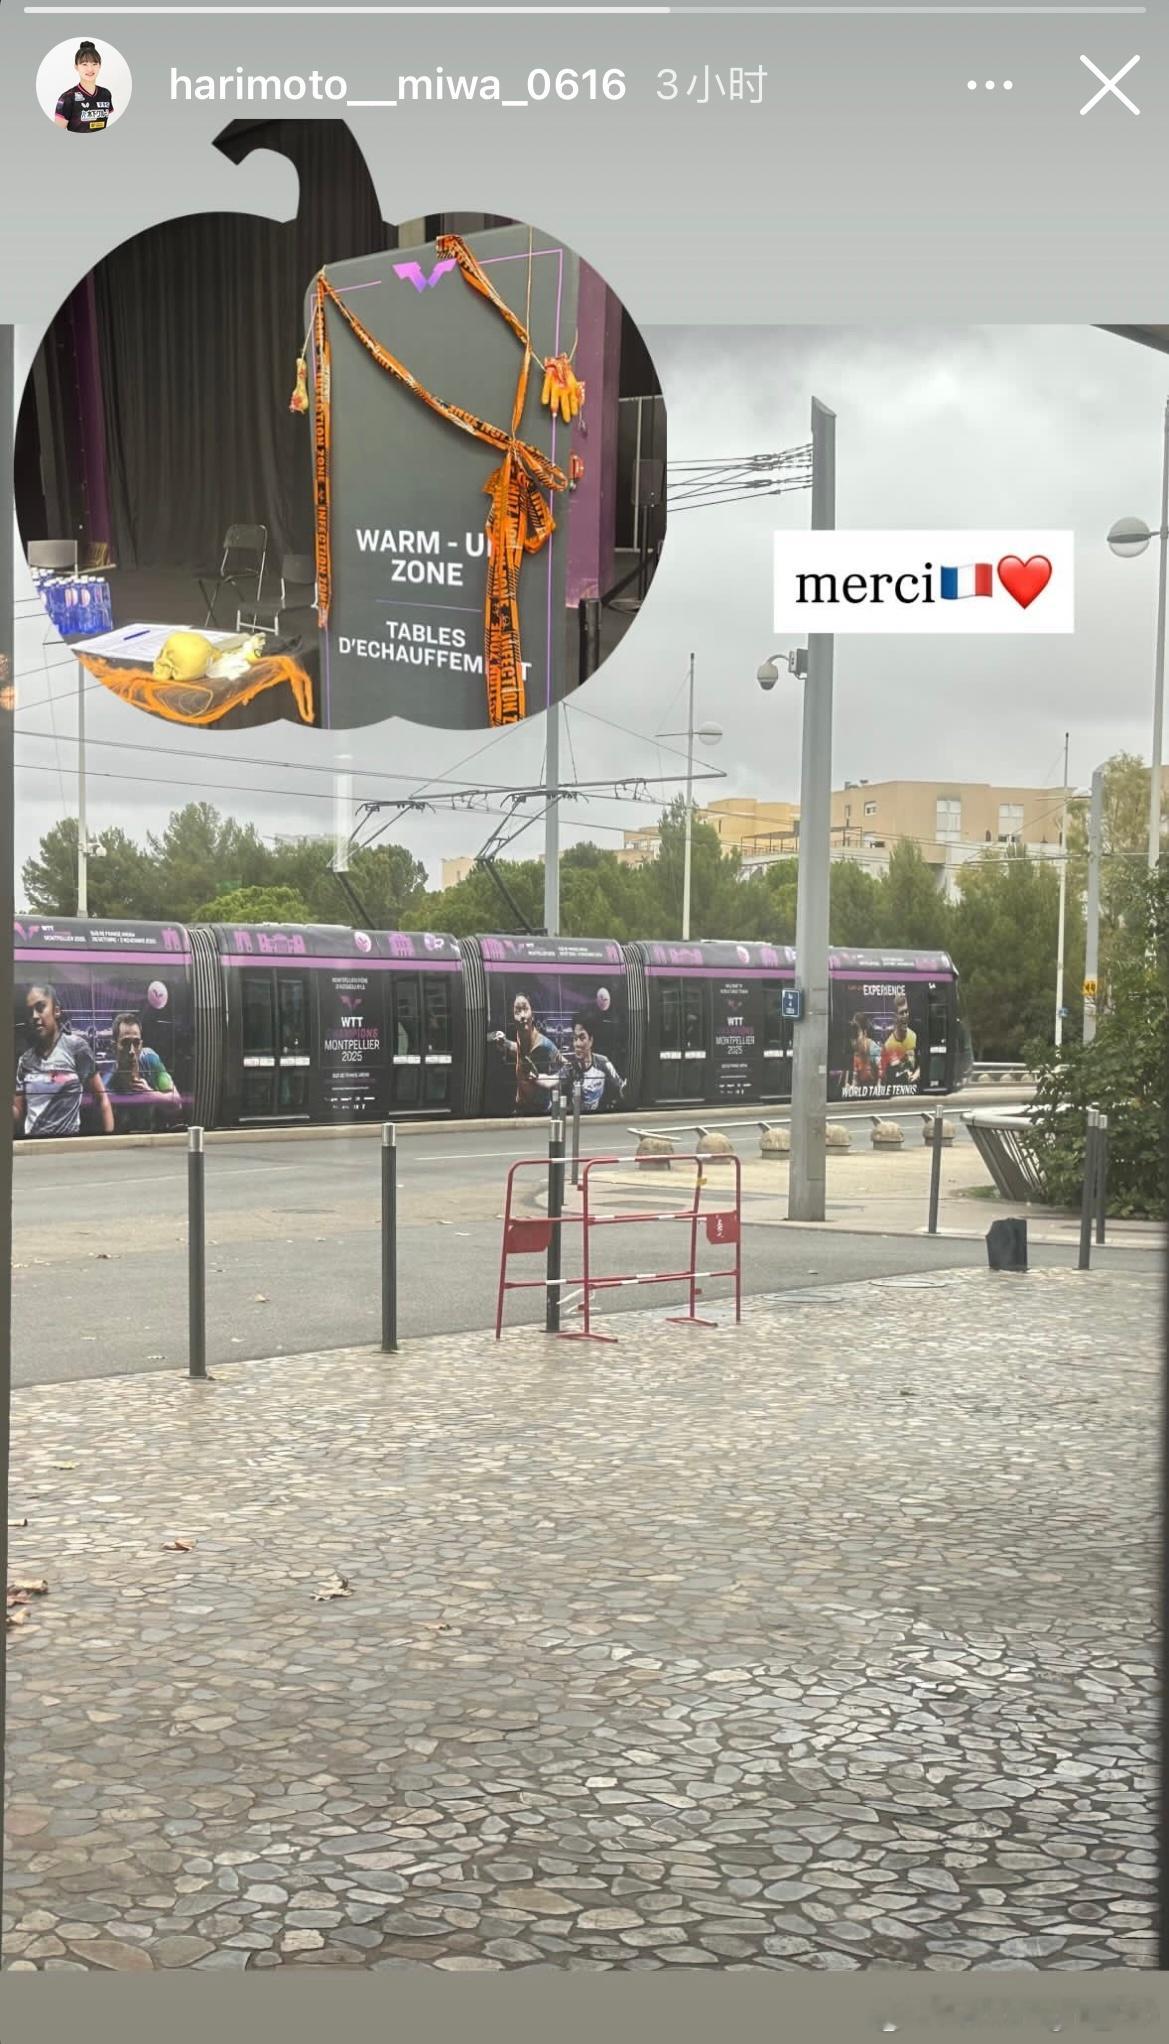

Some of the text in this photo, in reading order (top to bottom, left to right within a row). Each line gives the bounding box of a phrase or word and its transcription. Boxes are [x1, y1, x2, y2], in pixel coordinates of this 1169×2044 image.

[356, 529, 440, 553] WARM
[465, 531, 492, 557] U
[391, 559, 464, 586] ZONE
[386, 621, 466, 647] TABLES
[339, 637, 531, 682] D'ECHAUFFEMT
[863, 985, 906, 996] EXPERIENCE
[340, 1016, 364, 1027] WTT
[324, 1039, 380, 1050] MONTPELLIER
[341, 1051, 363, 1062] 2025
[841, 1086, 868, 1098] WORLD
[892, 1084, 918, 1095] TENNIS
